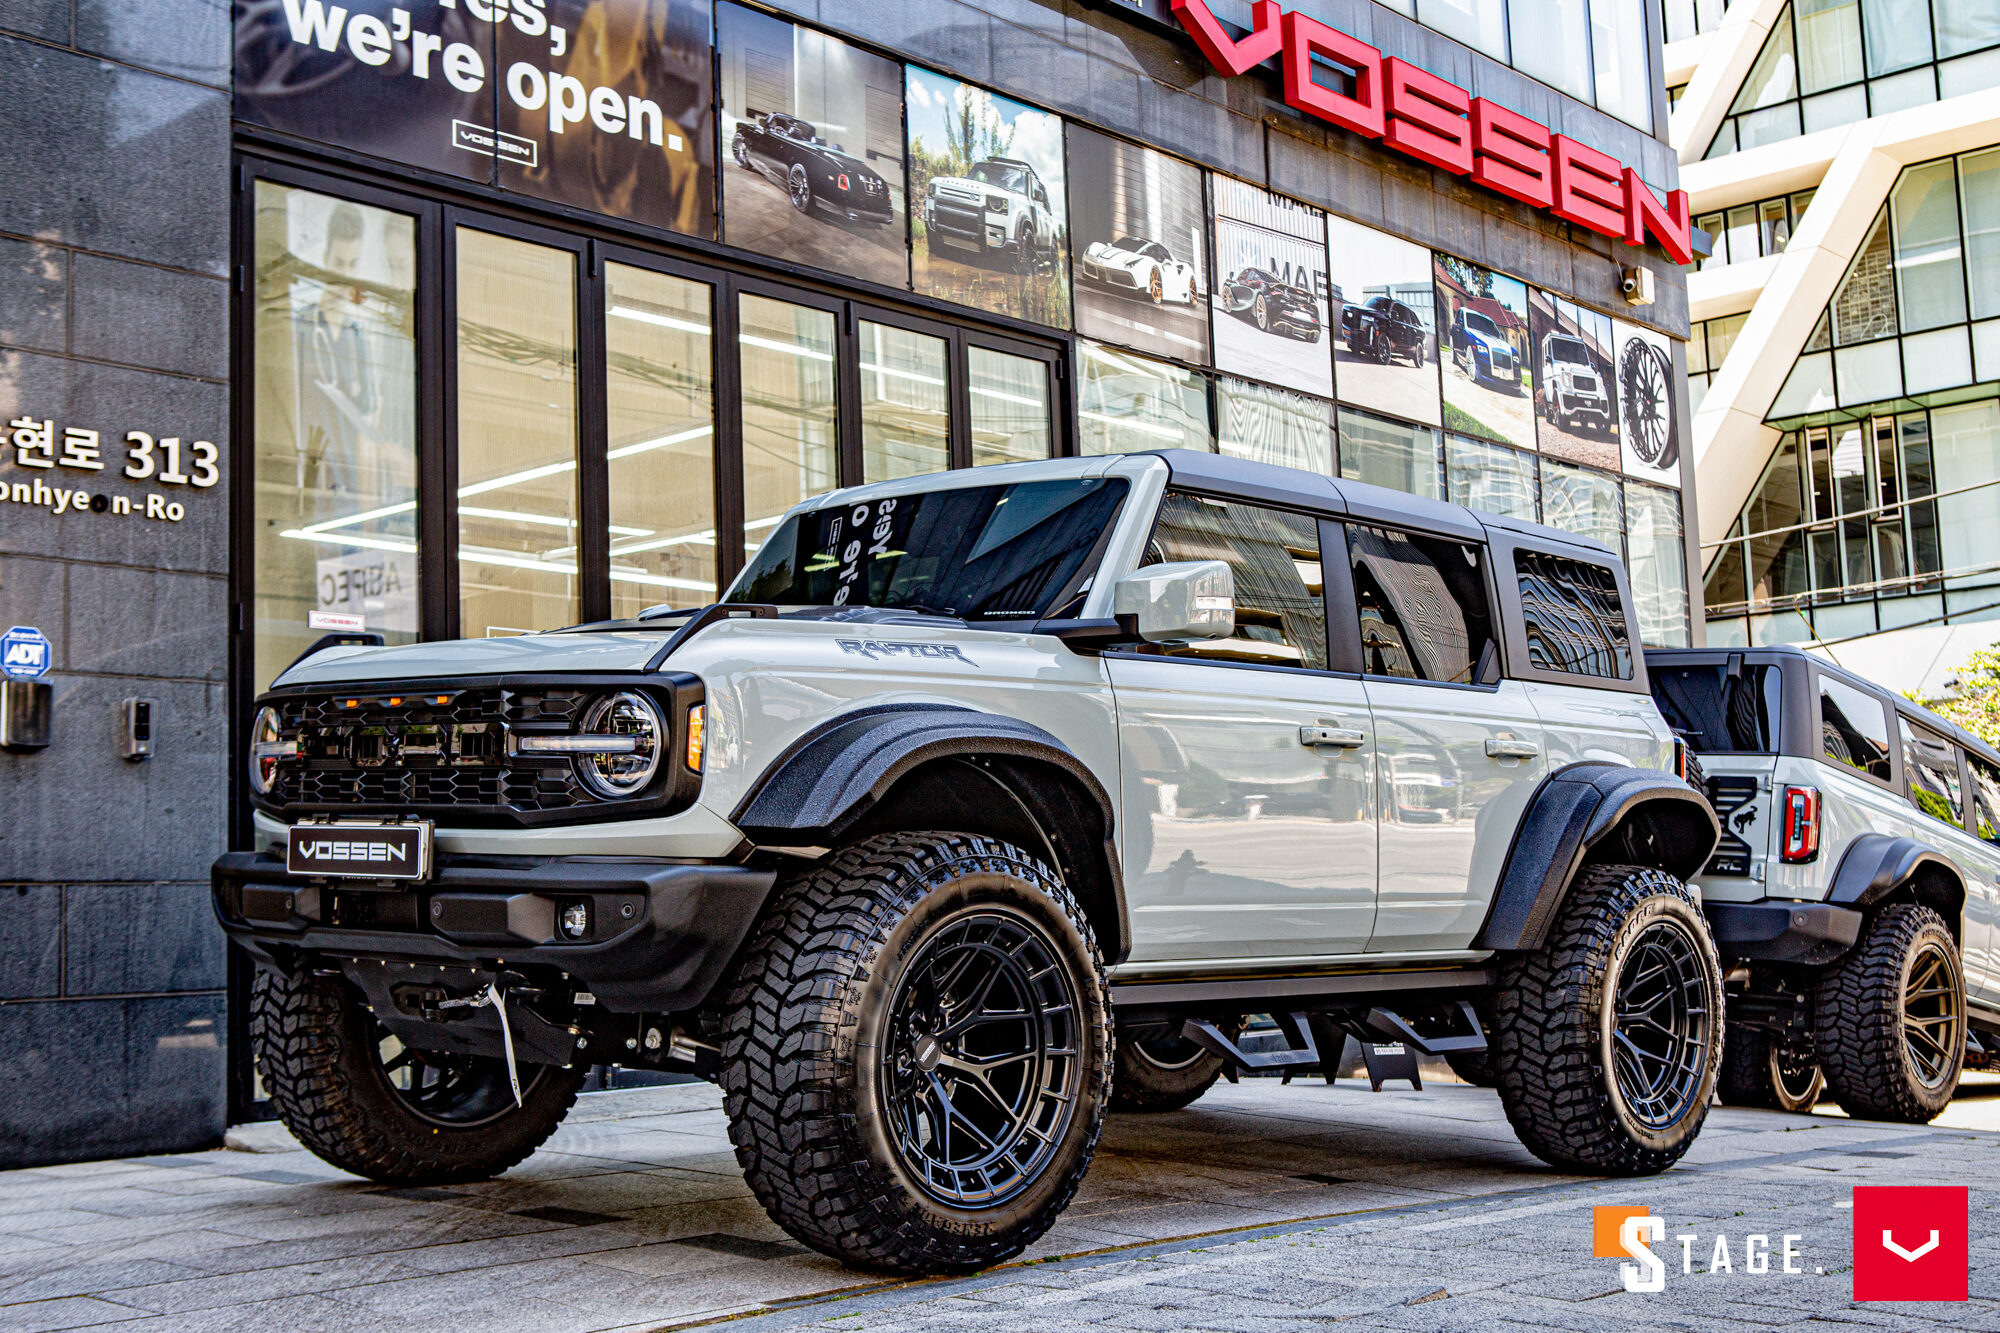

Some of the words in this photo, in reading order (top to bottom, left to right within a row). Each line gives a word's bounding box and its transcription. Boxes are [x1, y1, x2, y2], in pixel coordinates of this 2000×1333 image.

[280, 0, 486, 93] we're
[505, 61, 684, 152] open.
[460, 130, 531, 157] VOSSEN
[1171, 0, 1692, 265] VOSSEN
[0, 415, 105, 470] 현로
[124, 430, 220, 488] 313
[4, 643, 45, 665] ADT
[834, 638, 984, 671] RAPTOR
[298, 840, 407, 862] VOSSEN
